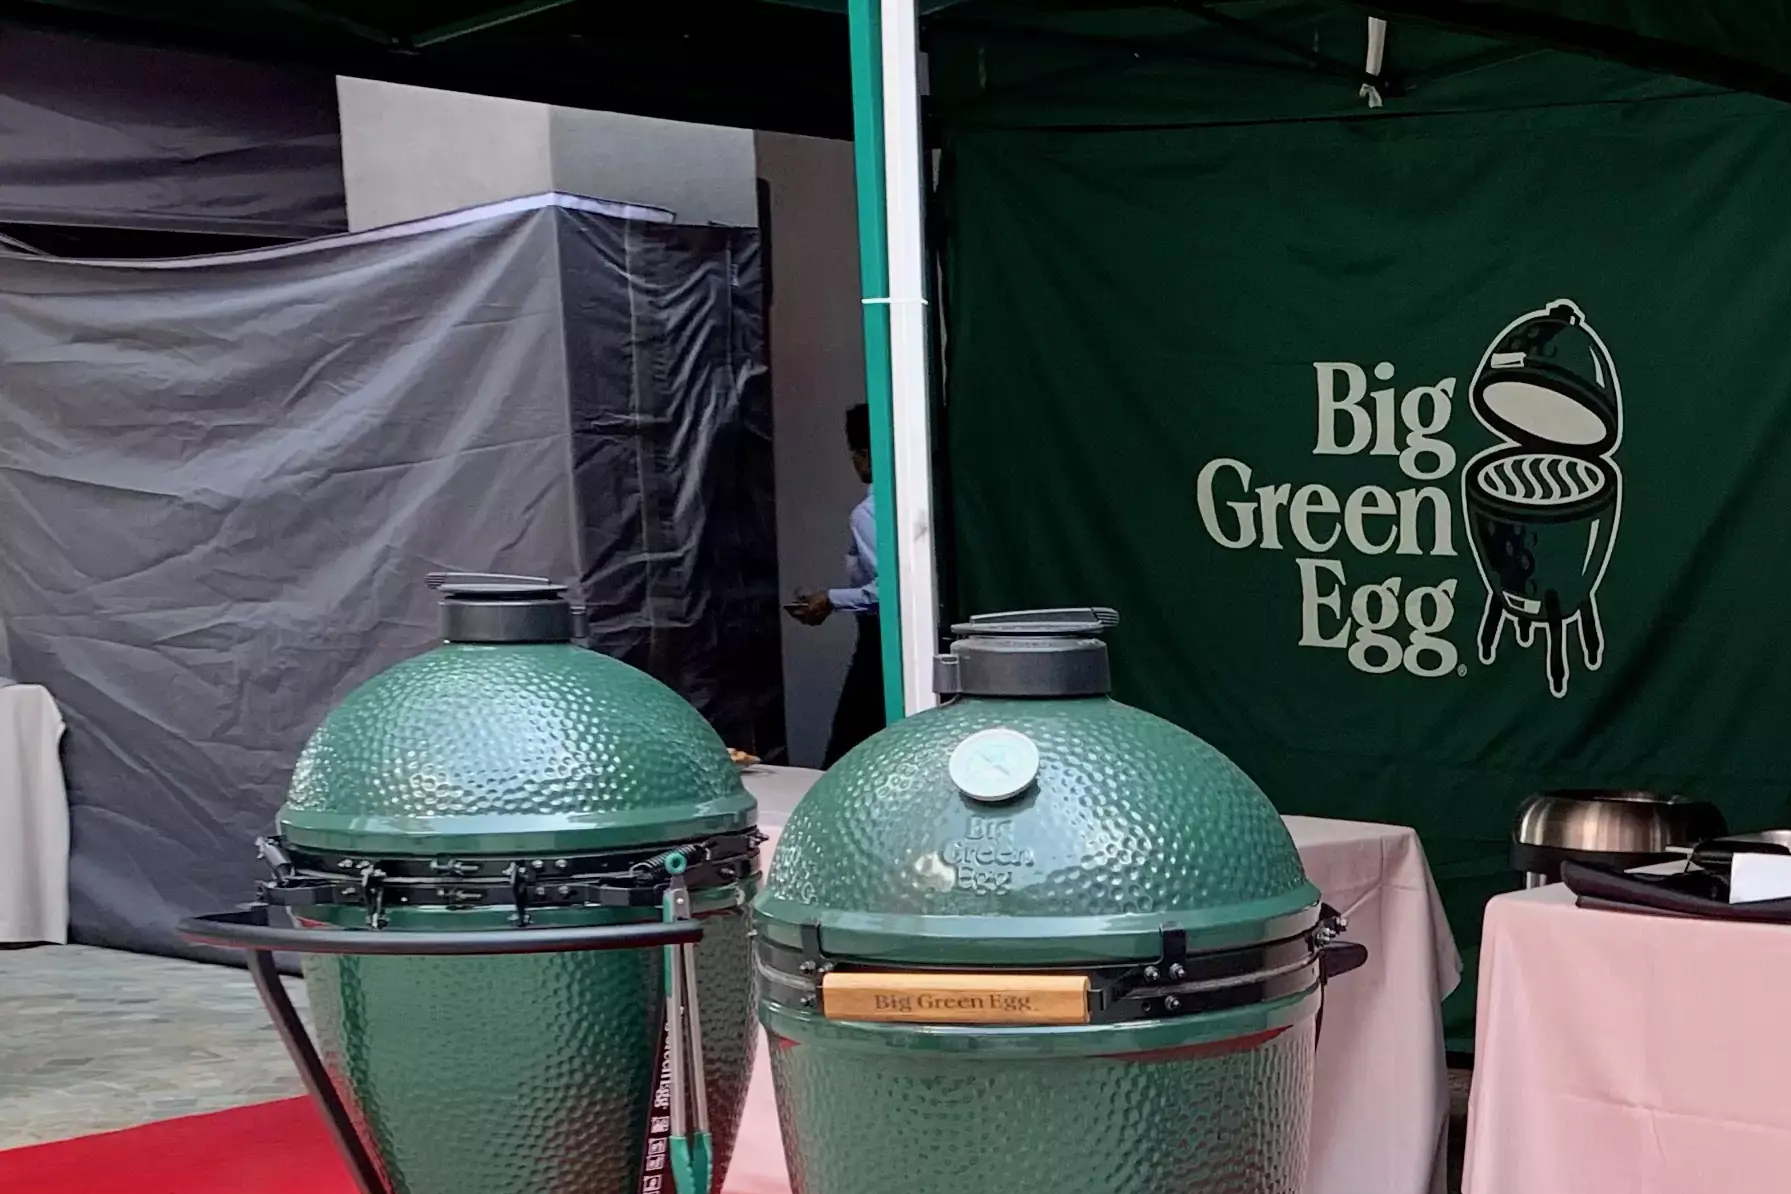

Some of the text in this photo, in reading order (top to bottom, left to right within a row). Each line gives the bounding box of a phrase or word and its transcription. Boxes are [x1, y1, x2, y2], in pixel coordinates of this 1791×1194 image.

[1312, 361, 1457, 480] Big
[1196, 458, 1458, 556] Green
[943, 841, 1036, 867] Green
[957, 867, 1013, 896] Egg
[874, 994, 912, 1012] Big
[917, 994, 984, 1010] Green
